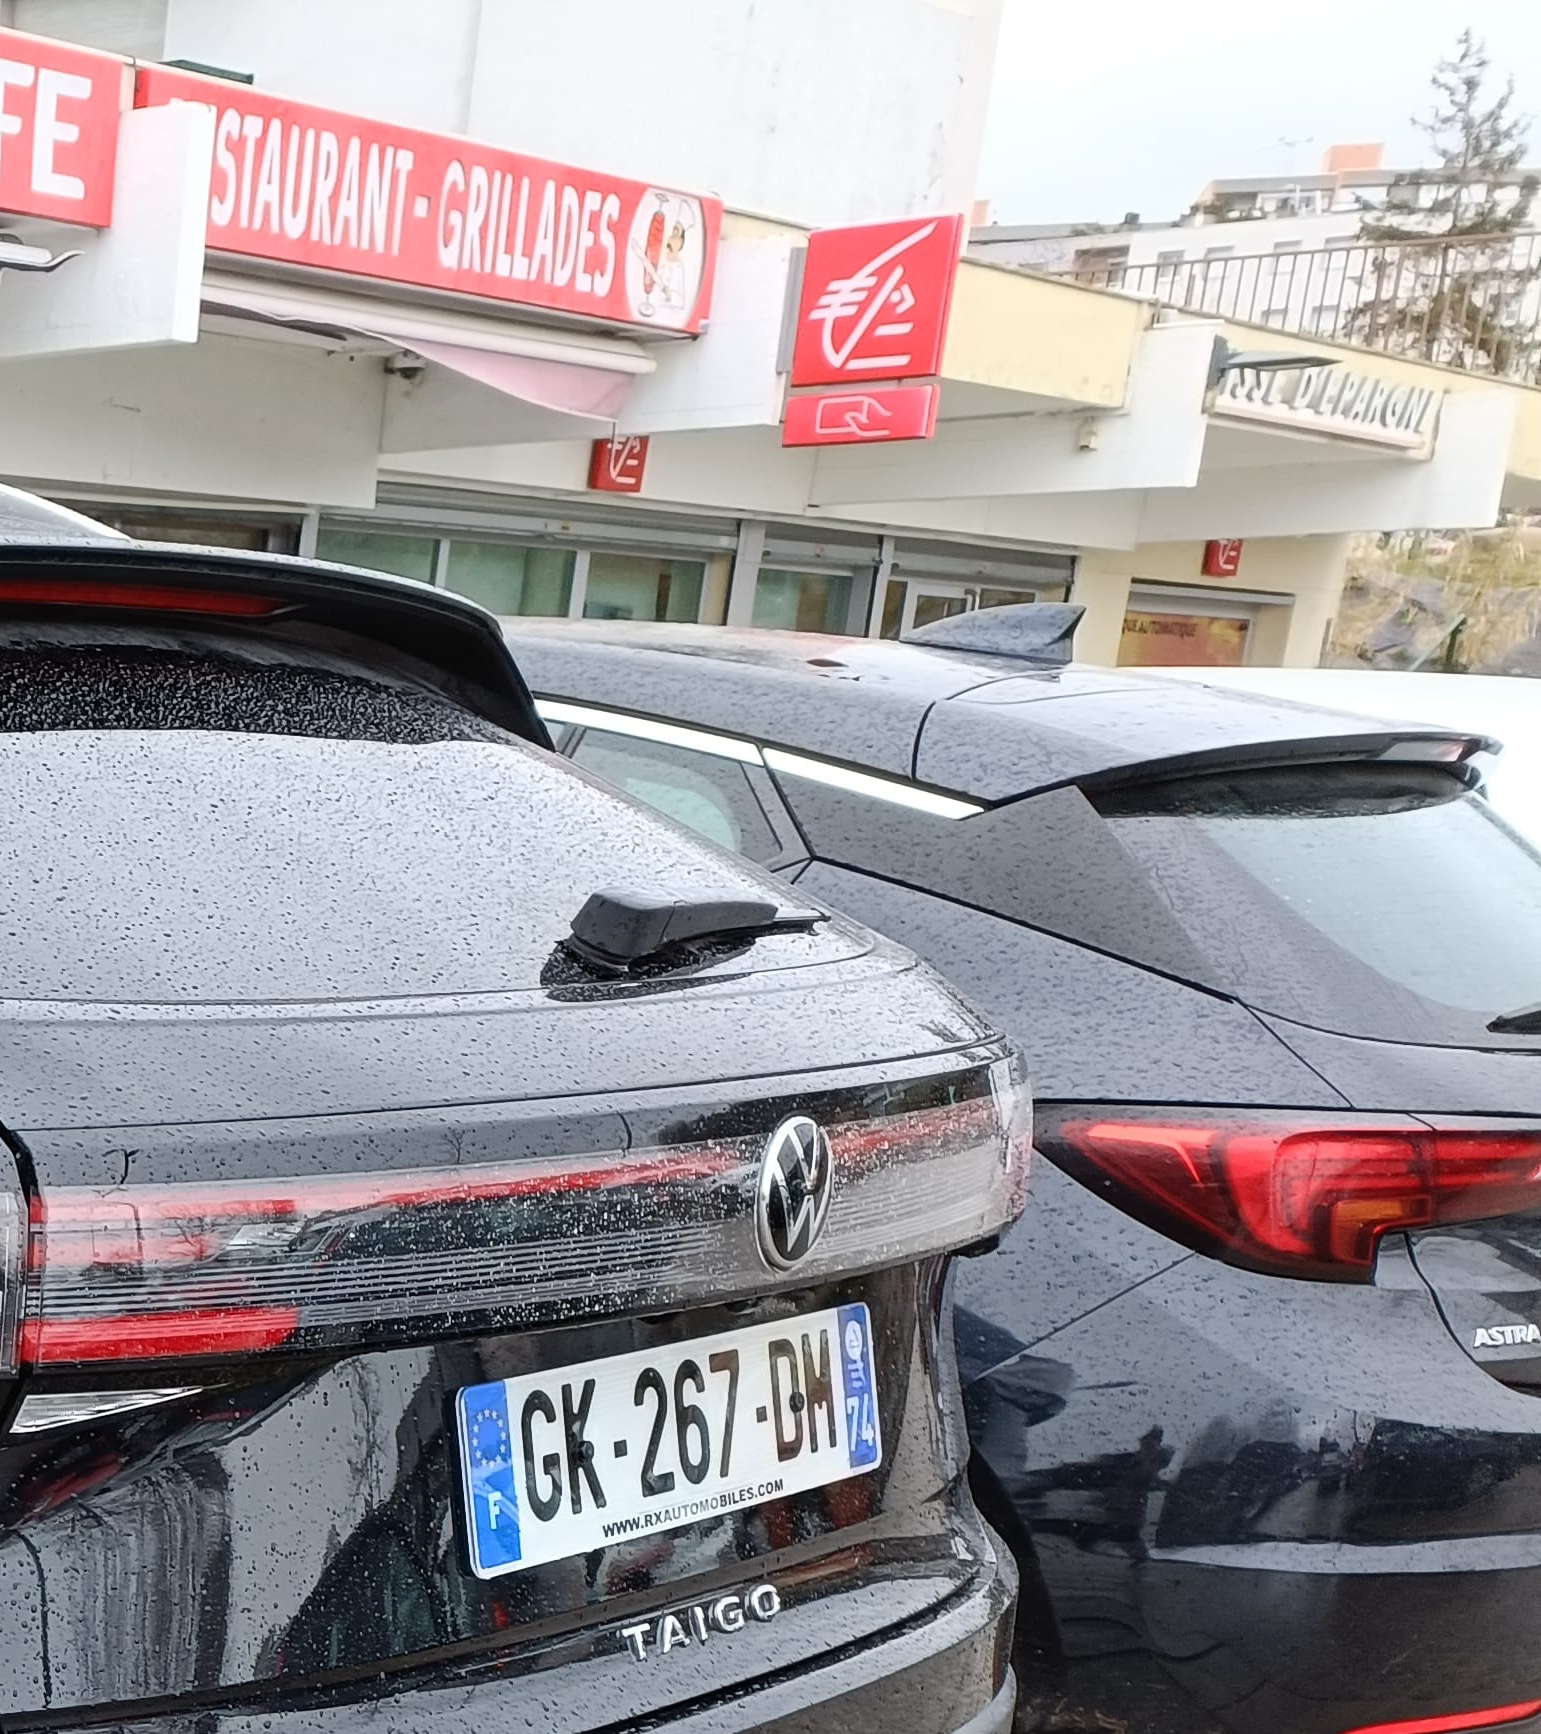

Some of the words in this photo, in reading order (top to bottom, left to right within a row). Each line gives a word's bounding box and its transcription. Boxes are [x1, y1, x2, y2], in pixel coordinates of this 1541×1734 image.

[210, 106, 415, 256] STAURANT
[437, 159, 621, 298] GRILLADES
[1473, 1323, 1541, 1348] ASTRA
[521, 1328, 838, 1522] GK-267-DM
[846, 1393, 874, 1452] 74
[488, 1491, 502, 1530] F
[602, 1478, 784, 1538] WWW.RXAUTOMOBILES.COM
[620, 1584, 782, 1662] TAIGO
